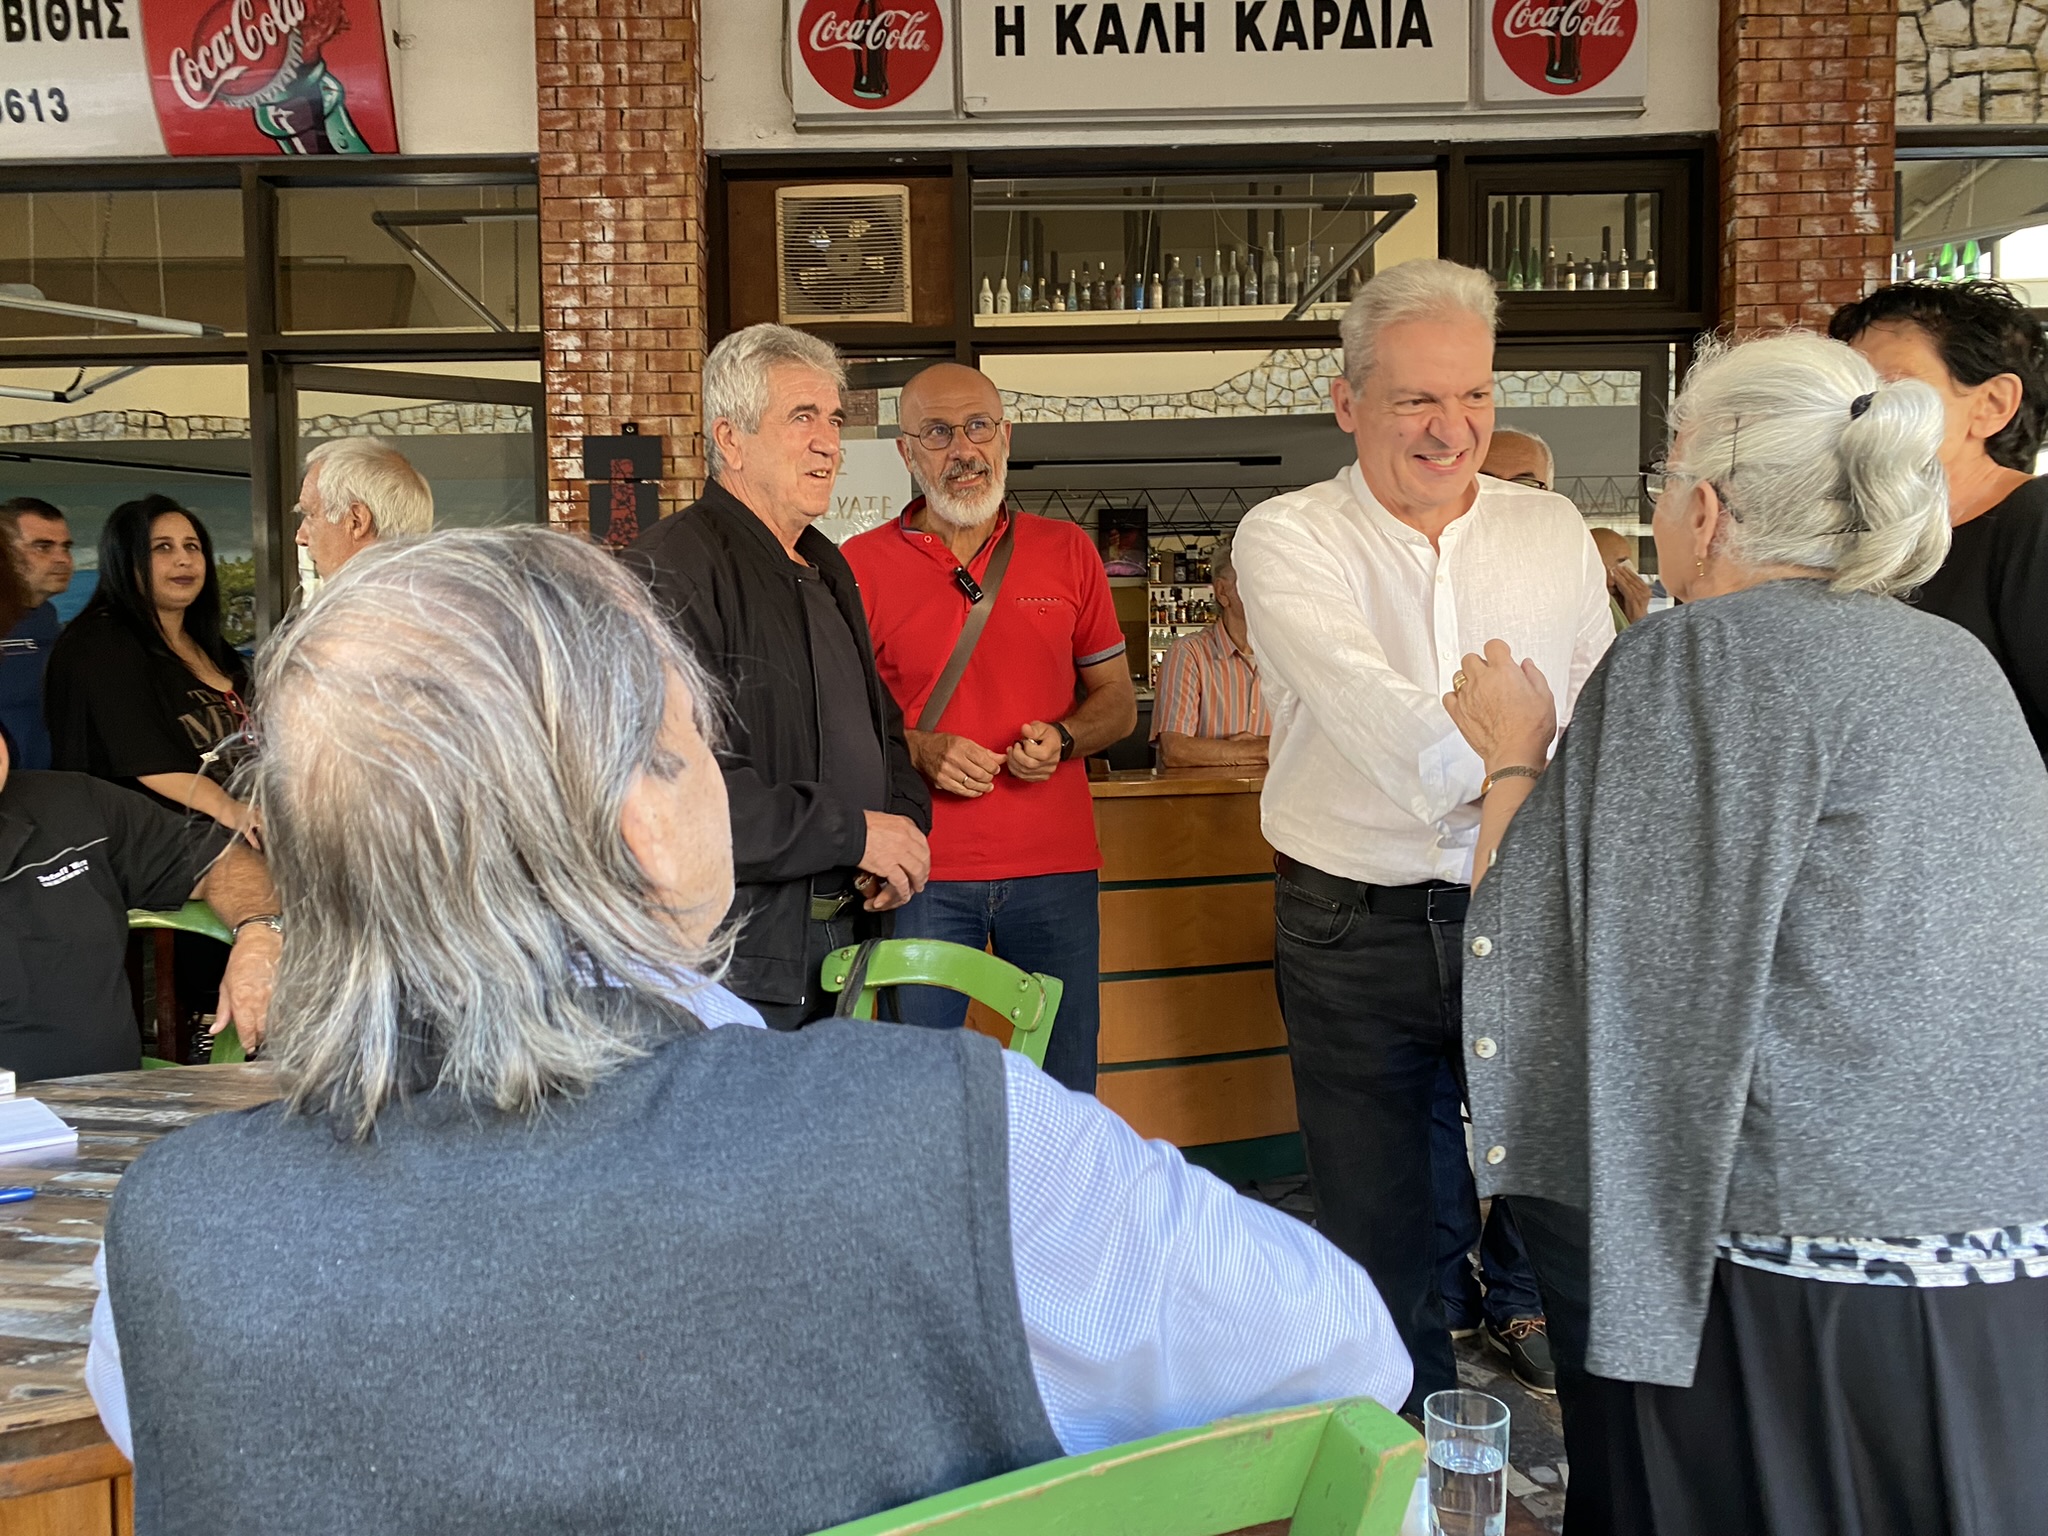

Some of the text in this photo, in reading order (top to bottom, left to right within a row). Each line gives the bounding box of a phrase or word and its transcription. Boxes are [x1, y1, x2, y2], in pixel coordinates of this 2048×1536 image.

[994, 0, 1433, 56] Η ΚΑΛΗ ΚΑΡΔΙΑ
[0, 87, 69, 122] 613
